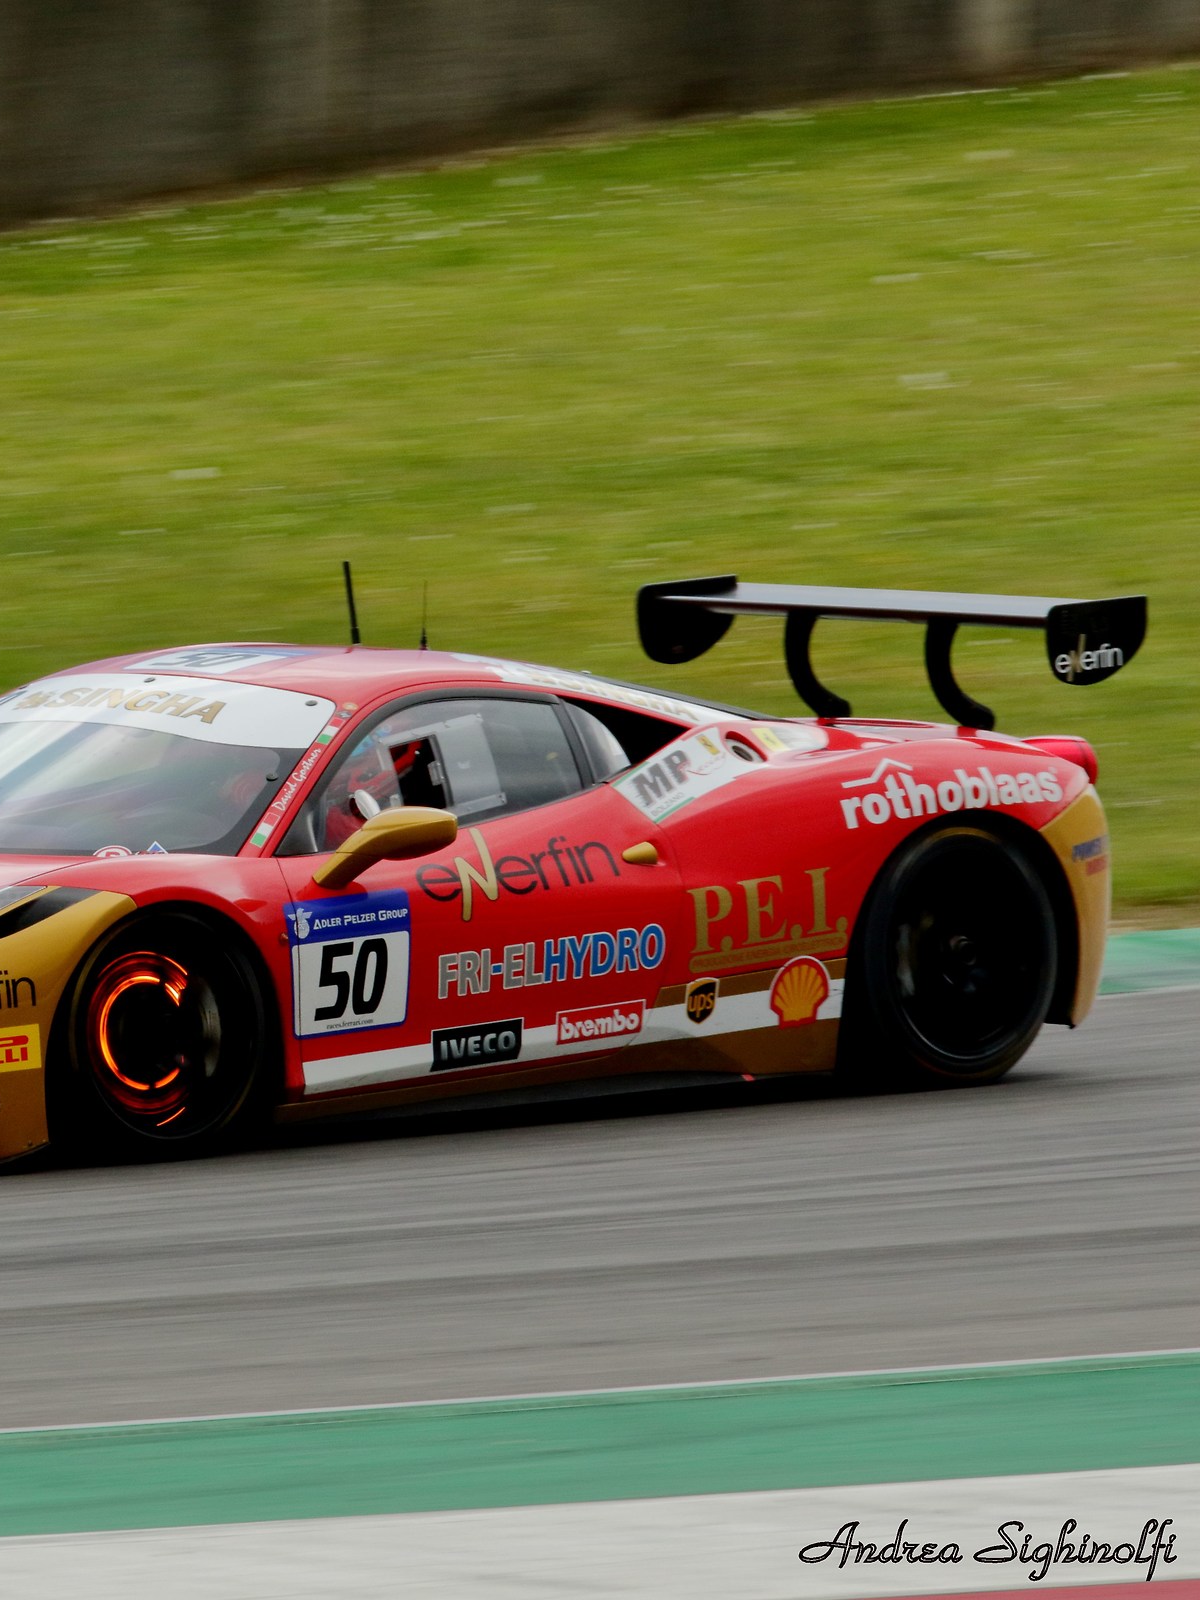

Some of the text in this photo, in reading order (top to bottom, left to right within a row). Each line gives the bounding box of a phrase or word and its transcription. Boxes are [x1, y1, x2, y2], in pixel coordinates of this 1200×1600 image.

[43, 687, 227, 725] SINGHA
[271, 781, 297, 811] David
[632, 750, 690, 807] MP
[840, 766, 1063, 830] rothoblaas
[313, 908, 408, 930] ADLER PELZER GROUP
[687, 867, 849, 954] P.E.I.
[314, 937, 388, 1022] 50
[560, 1010, 640, 1042] brembo
[440, 1030, 516, 1061] IVECO
